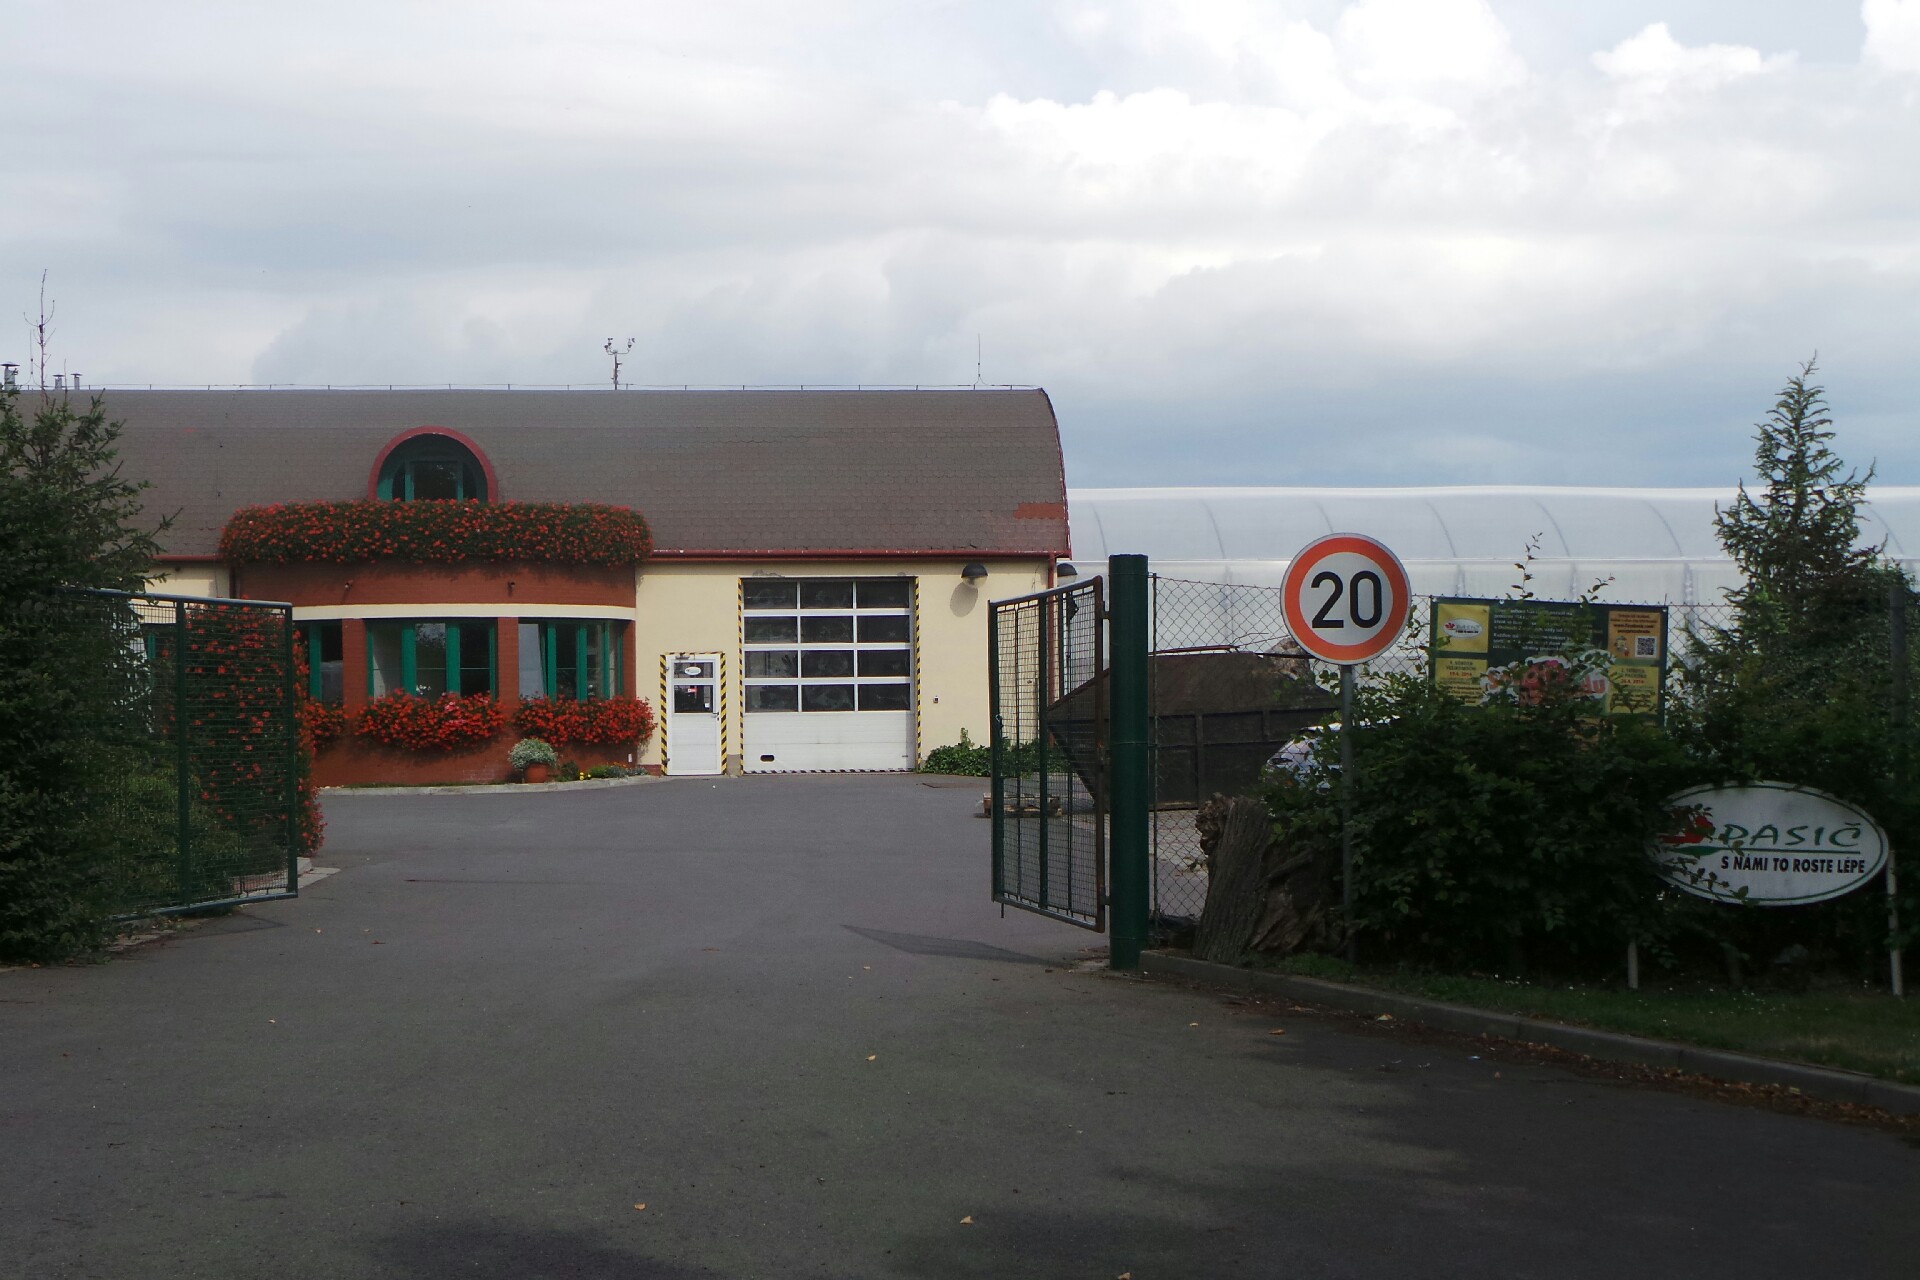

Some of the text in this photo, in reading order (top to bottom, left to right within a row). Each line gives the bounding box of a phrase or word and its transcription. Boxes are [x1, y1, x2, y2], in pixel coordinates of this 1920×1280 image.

[1311, 570, 1382, 628] 20
[1721, 854, 1865, 873] S NÁMI TO ROSTE LÉPE
